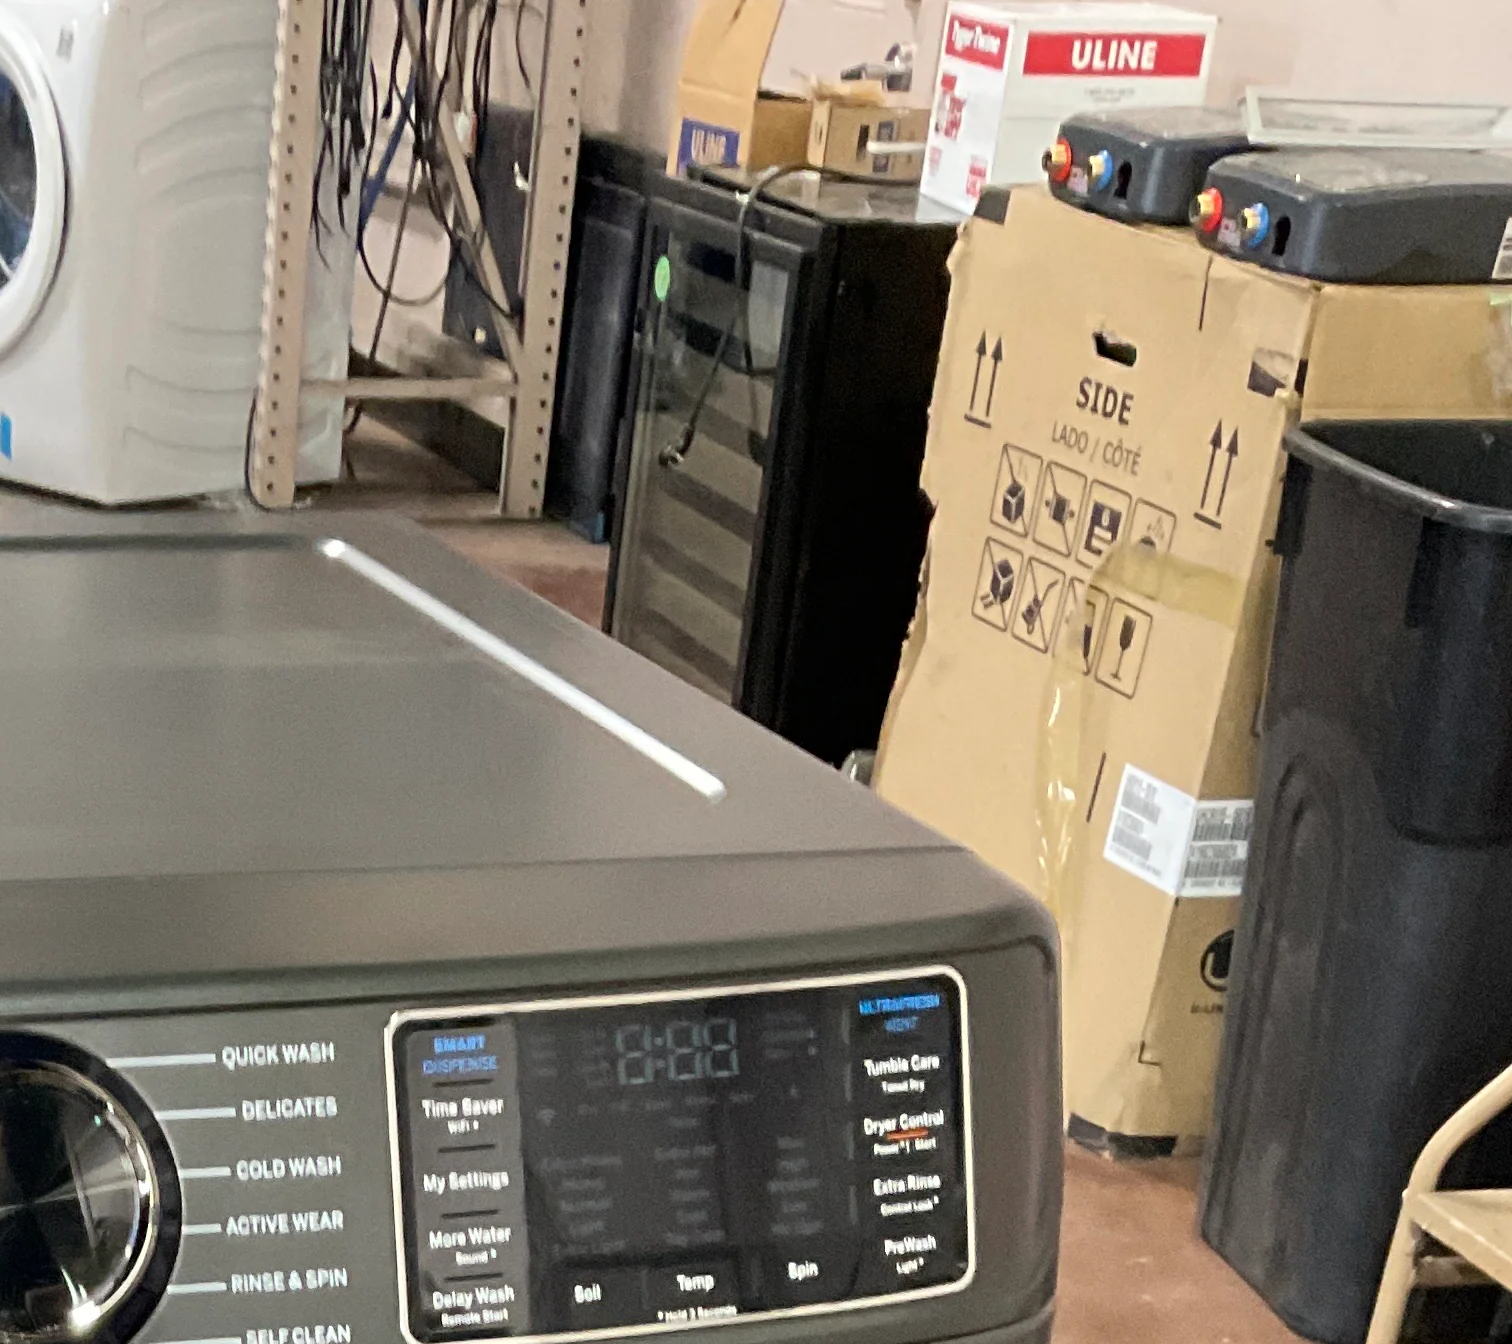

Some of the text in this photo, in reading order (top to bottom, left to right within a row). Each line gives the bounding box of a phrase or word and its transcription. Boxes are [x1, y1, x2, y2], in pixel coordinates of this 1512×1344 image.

[1071, 39, 1158, 71] ULINE
[1075, 376, 1134, 426] SIDE
[1051, 420, 1142, 476] LADO / CÔTÉ
[221, 1041, 335, 1071] QUICK WASH
[434, 1035, 486, 1053] SMART
[422, 1055, 497, 1075] DISPENSE
[863, 1054, 940, 1076] Tumble Care
[242, 1095, 338, 1121] DELICATES
[421, 1097, 504, 1119] Time Saver
[864, 1109, 944, 1136] Dryer Control
[237, 1155, 342, 1180] COLD WASH
[423, 1171, 510, 1195] My Settings
[873, 1174, 941, 1196] Extra Rinse
[226, 1210, 344, 1236] ACTIVE WEAR
[429, 1226, 512, 1249] More Water
[231, 1266, 348, 1294] RINSE & SPIN
[676, 1274, 714, 1292] Temp
[788, 1260, 819, 1281] Spin
[432, 1284, 515, 1310] Delay Wash
